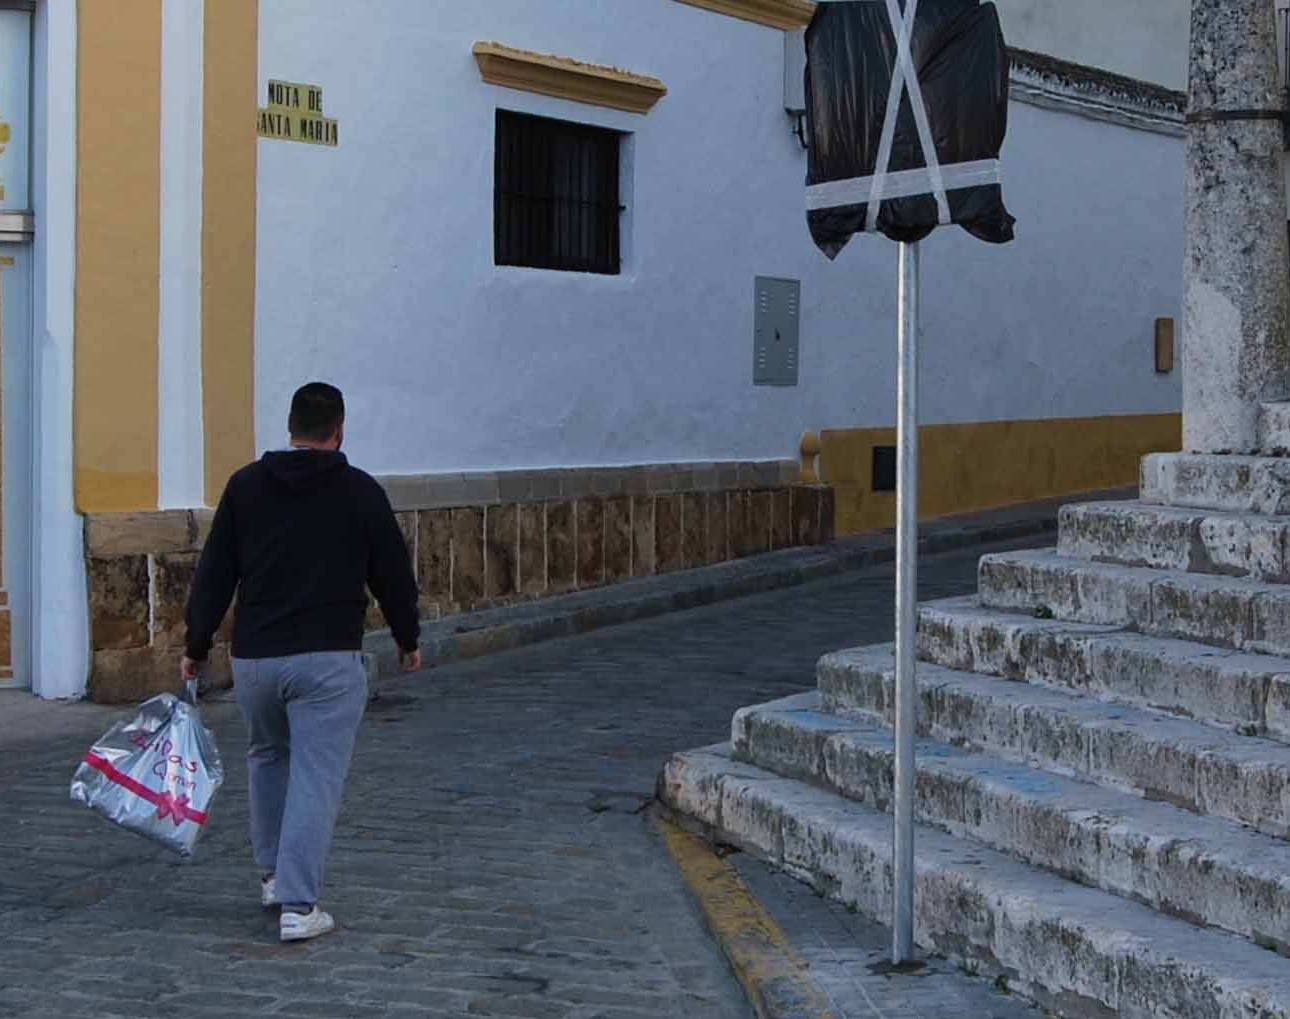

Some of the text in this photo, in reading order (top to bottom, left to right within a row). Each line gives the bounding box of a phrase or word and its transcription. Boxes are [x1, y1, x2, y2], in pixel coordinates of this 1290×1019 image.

[268, 82, 323, 112] MOTA DE
[301, 117, 338, 146] MARIA
